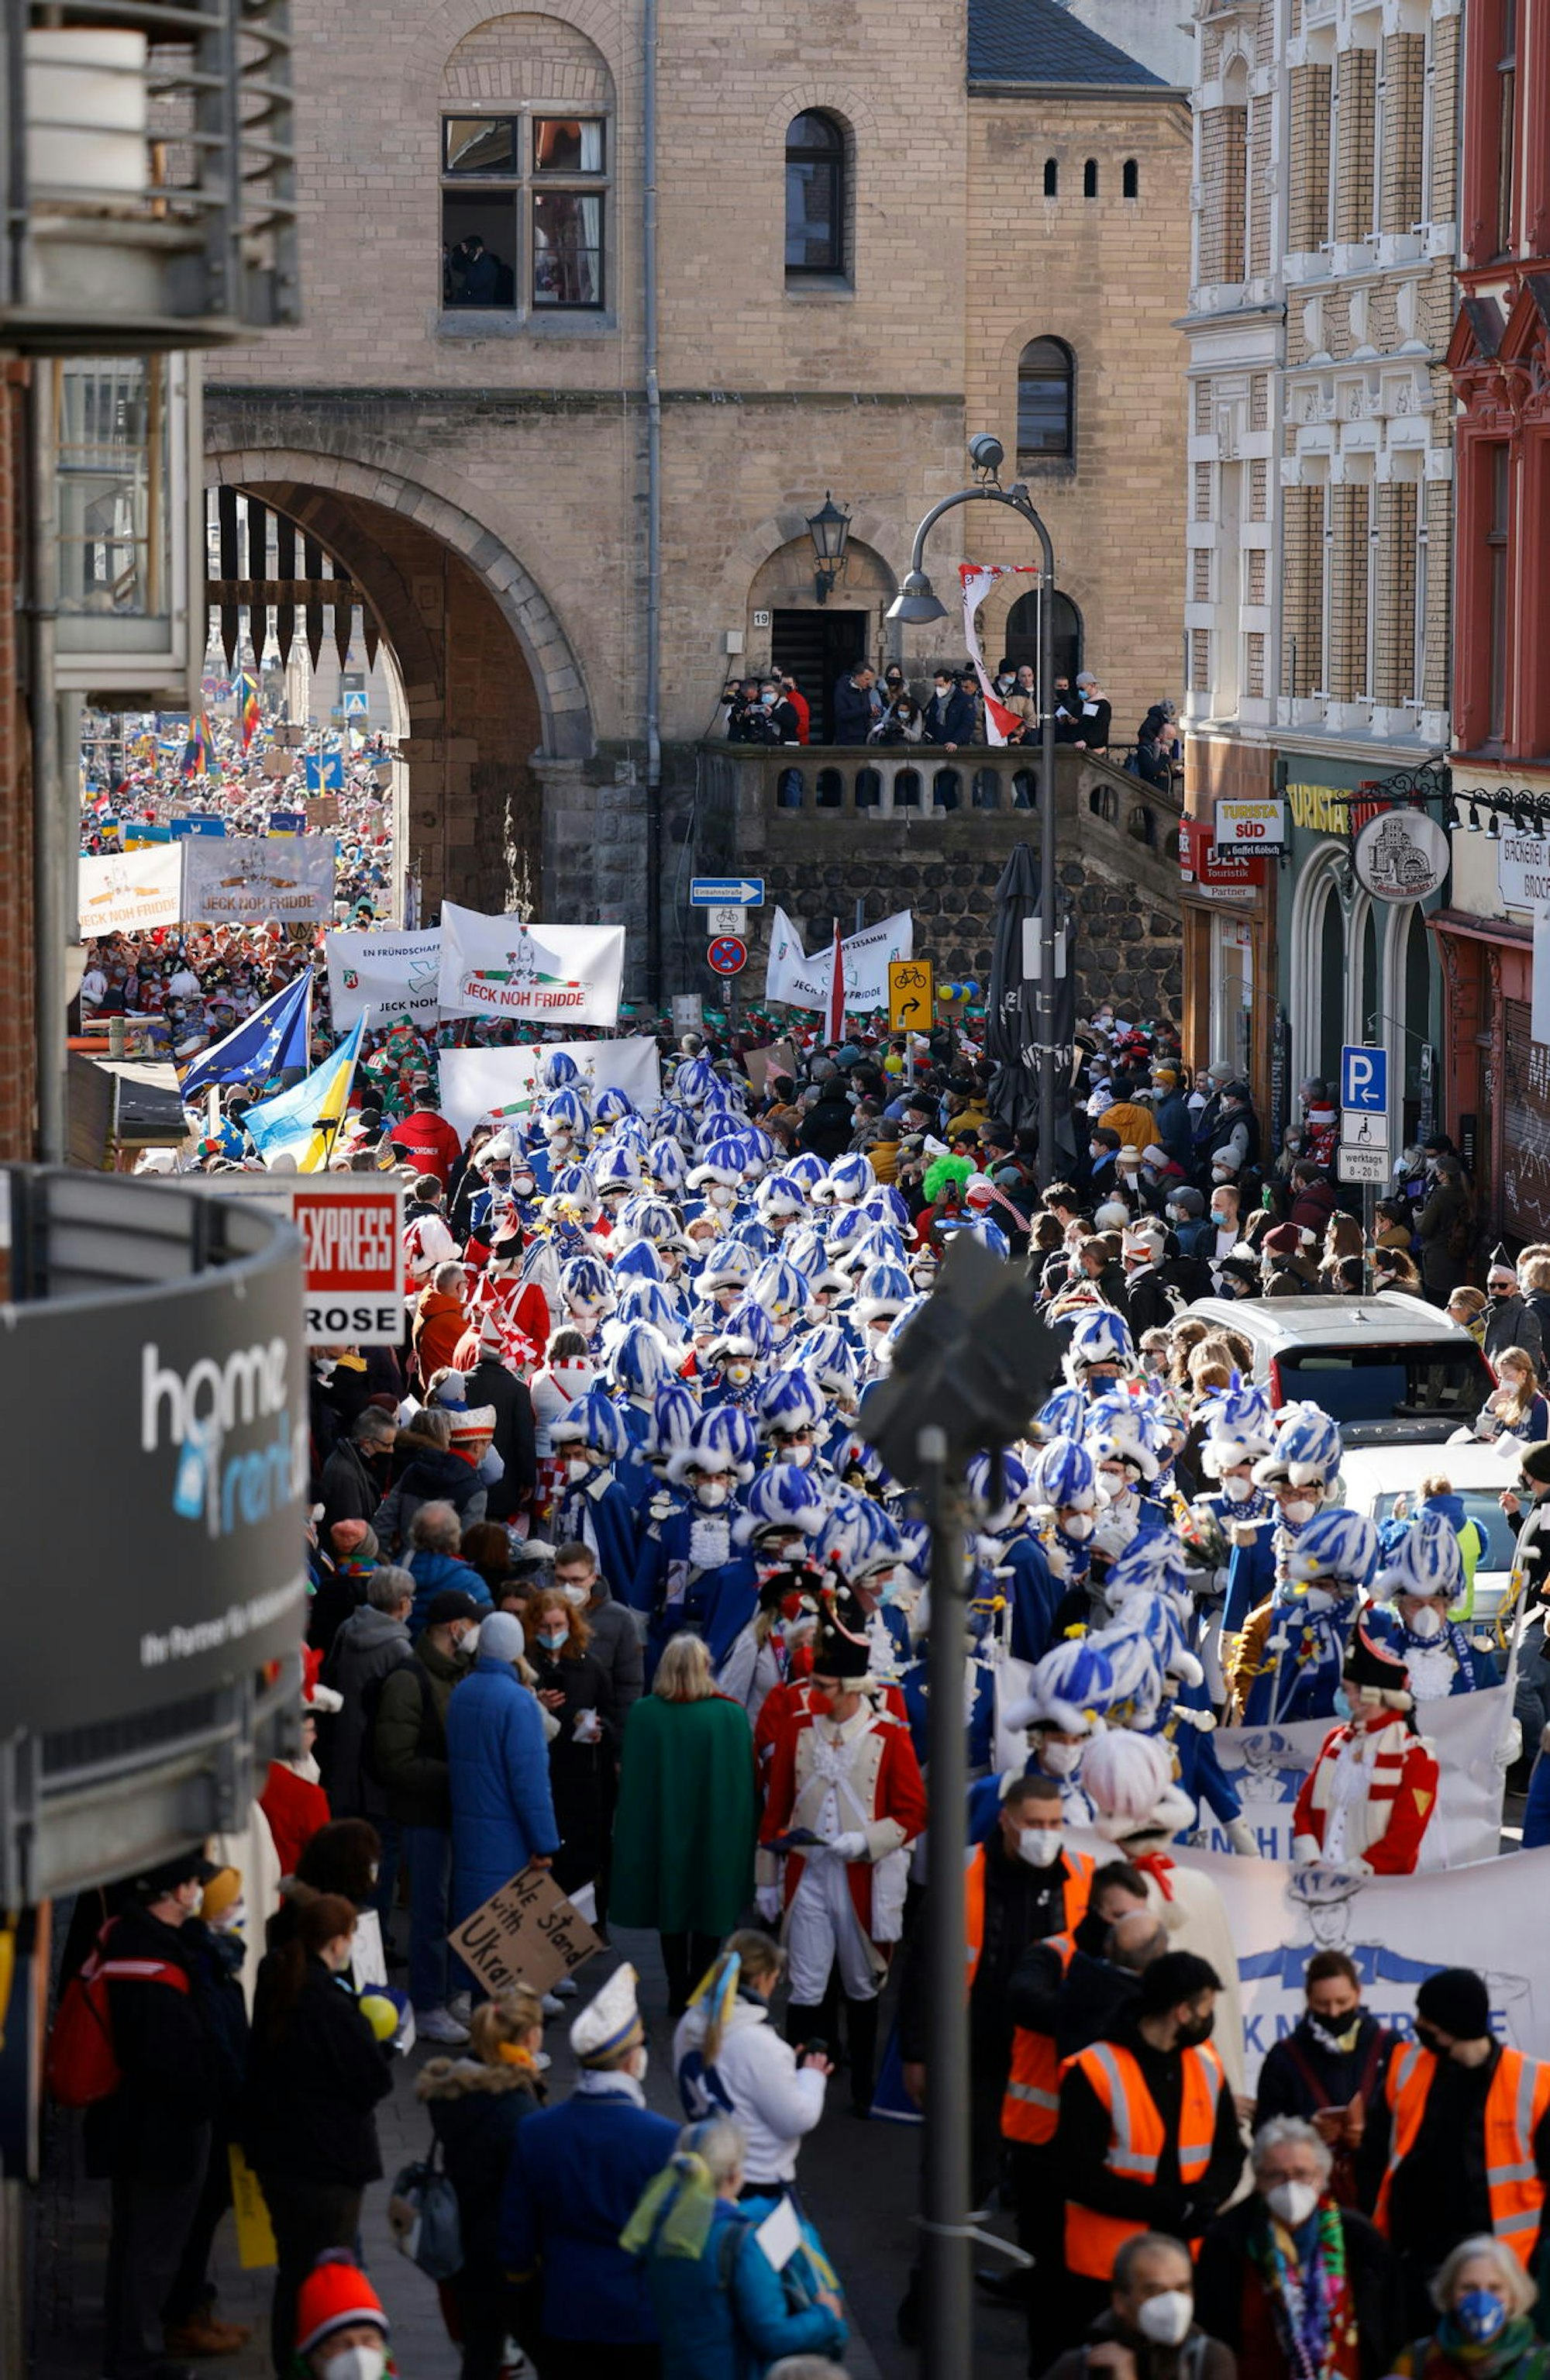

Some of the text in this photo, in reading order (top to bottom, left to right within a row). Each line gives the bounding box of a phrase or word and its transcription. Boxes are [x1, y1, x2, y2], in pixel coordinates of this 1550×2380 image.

[754, 613, 768, 624] 19
[1221, 804, 1280, 819] TURISTA
[1286, 783, 1353, 834] TURISTA
[1235, 821, 1266, 838] SÜD
[1231, 844, 1280, 855] Gaffel Kölsch
[1504, 837, 1543, 866] BÄCKEREI
[1207, 868, 1249, 878] Touristik
[1211, 887, 1247, 896] Partner
[109, 908, 134, 923] NOH
[136, 897, 177, 918] FRIDDE
[202, 894, 315, 911] JECK NOH FRIDDE
[852, 933, 888, 949] ZESAMME
[363, 949, 375, 957] EN
[463, 982, 585, 1008] JECK NOH FRIDDE
[849, 986, 881, 1000] FRIDDE
[379, 997, 438, 1012] JECK NOH
[1348, 1054, 1373, 1102] P
[1345, 1153, 1383, 1166] werktags
[1349, 1166, 1355, 1176] 8
[1362, 1167, 1372, 1177] 20
[297, 1207, 393, 1272] EXPRESS
[305, 1308, 397, 1332] ROSE
[142, 1338, 288, 1454] home
[1211, 1826, 1278, 1860] NH
[491, 1897, 526, 1936] with
[536, 1913, 594, 1969] stand
[460, 1914, 523, 1989] Ukrai
